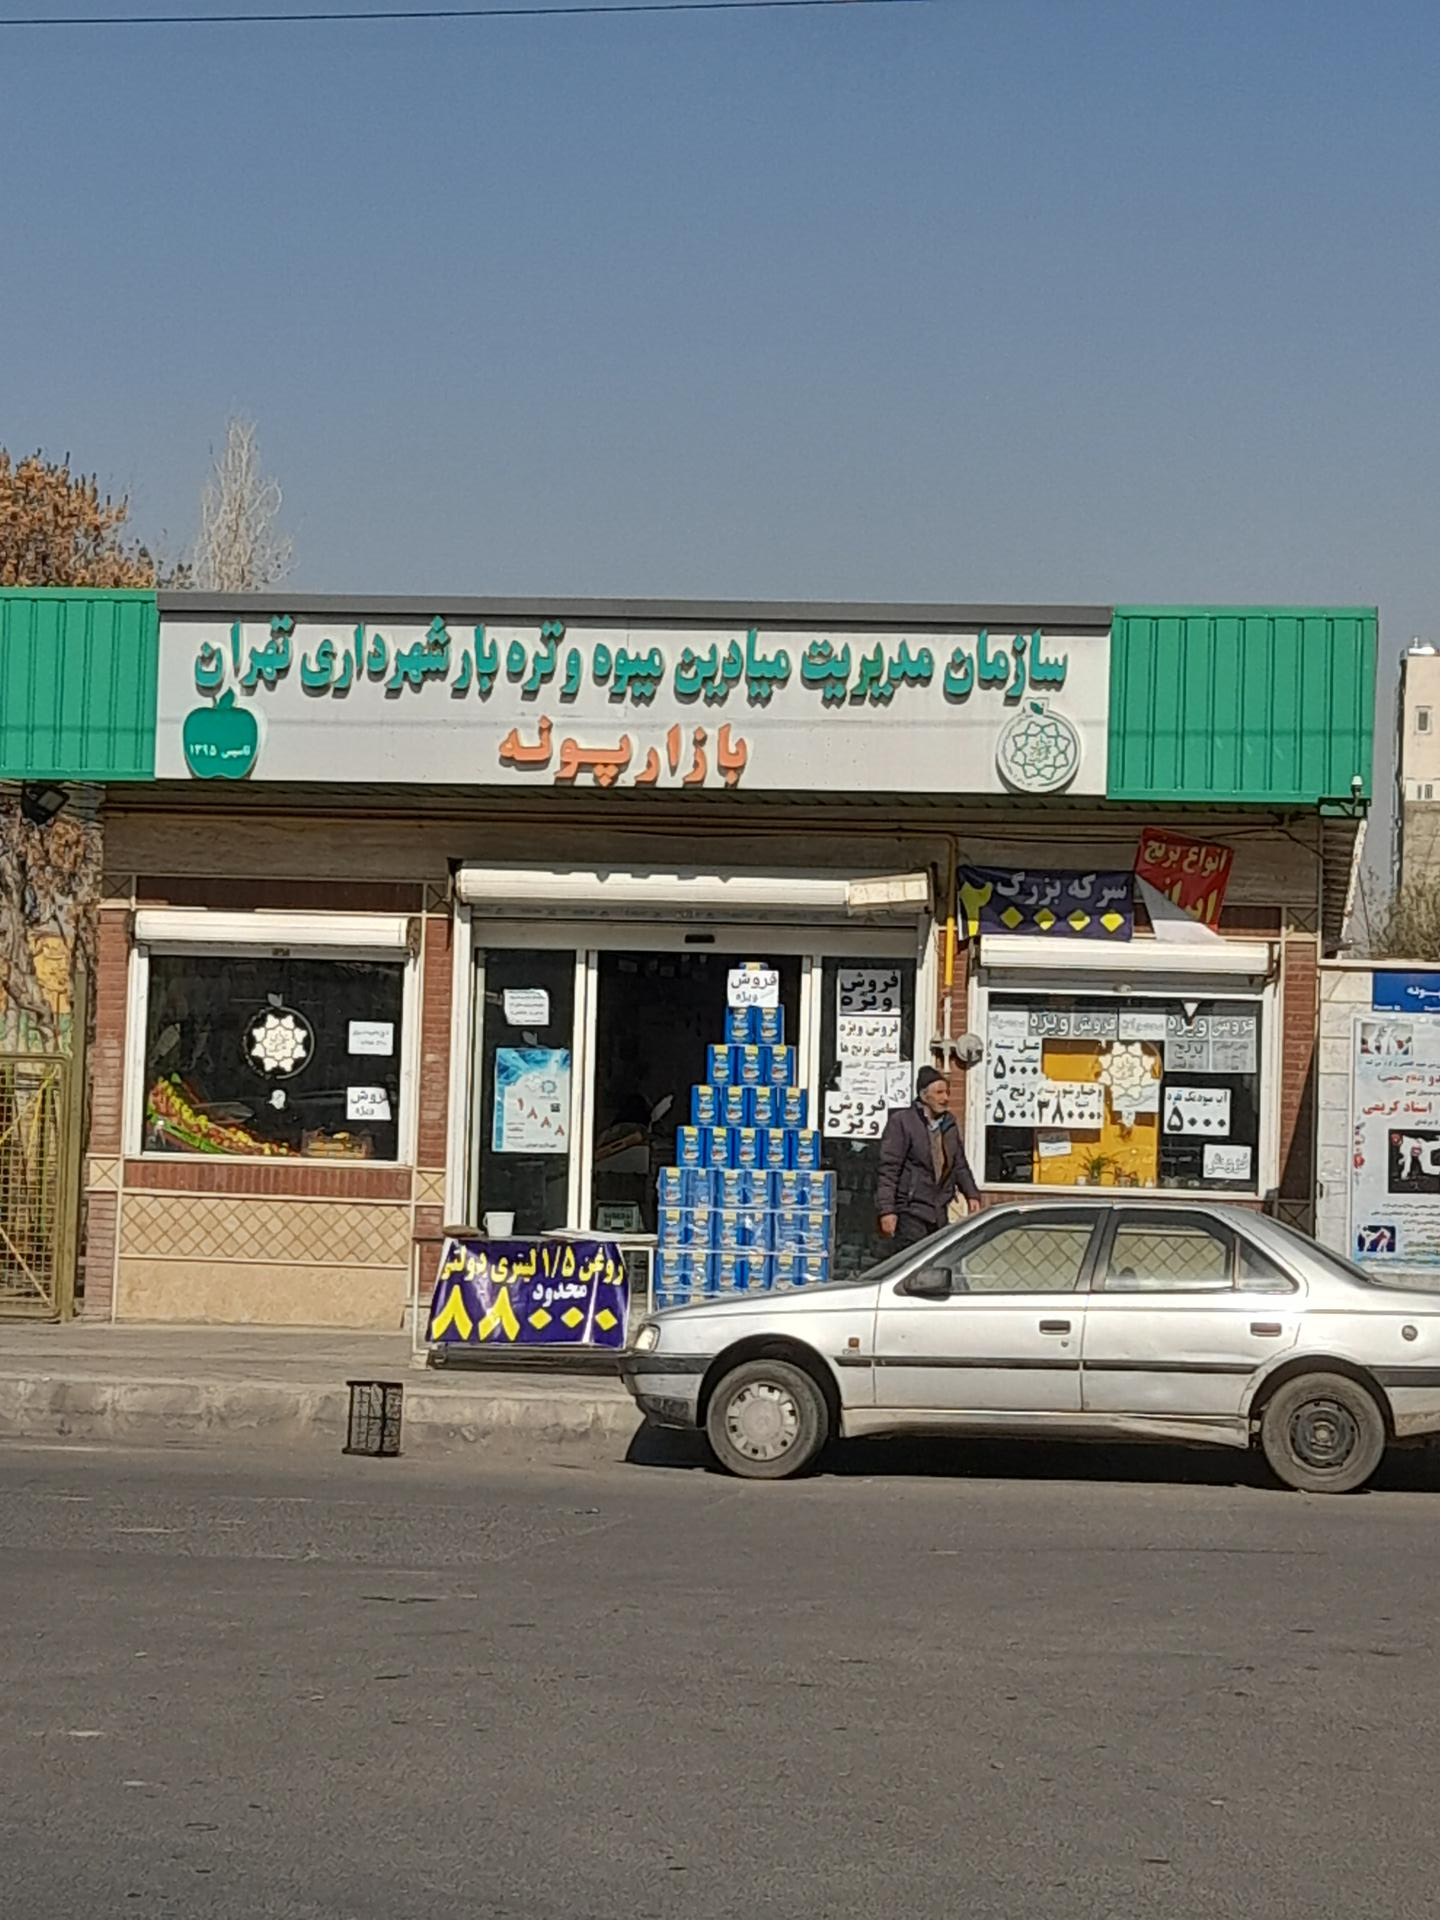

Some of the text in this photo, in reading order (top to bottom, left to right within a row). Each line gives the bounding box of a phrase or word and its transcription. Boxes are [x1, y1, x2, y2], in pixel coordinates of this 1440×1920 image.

[194, 614, 1068, 703] سازمان مدیریت میادین میوه و تره بار شهرداری تهران
[498, 715, 747, 788] بازار پونه
[1144, 836, 1228, 877] انواع برنج
[996, 871, 1127, 907] سرکه بزرگ
[731, 972, 778, 990] فروش
[841, 971, 899, 993] فروش
[840, 992, 893, 1012] ویژه
[839, 1019, 899, 1037] فروش ویژه
[1029, 1011, 1070, 1035] ویژه
[1073, 1015, 1116, 1036] فروش
[350, 1090, 388, 1104] روش
[828, 1094, 886, 1116] فروش
[828, 1113, 880, 1135] ویژه
[1167, 1106, 1226, 1132] ۵۰۰۰
[490, 1247, 537, 1284] لیتری
[578, 1246, 624, 1286] روغن
[532, 1282, 588, 1308] محدود
[431, 1284, 619, 1342] ۸۸۰۰۰
